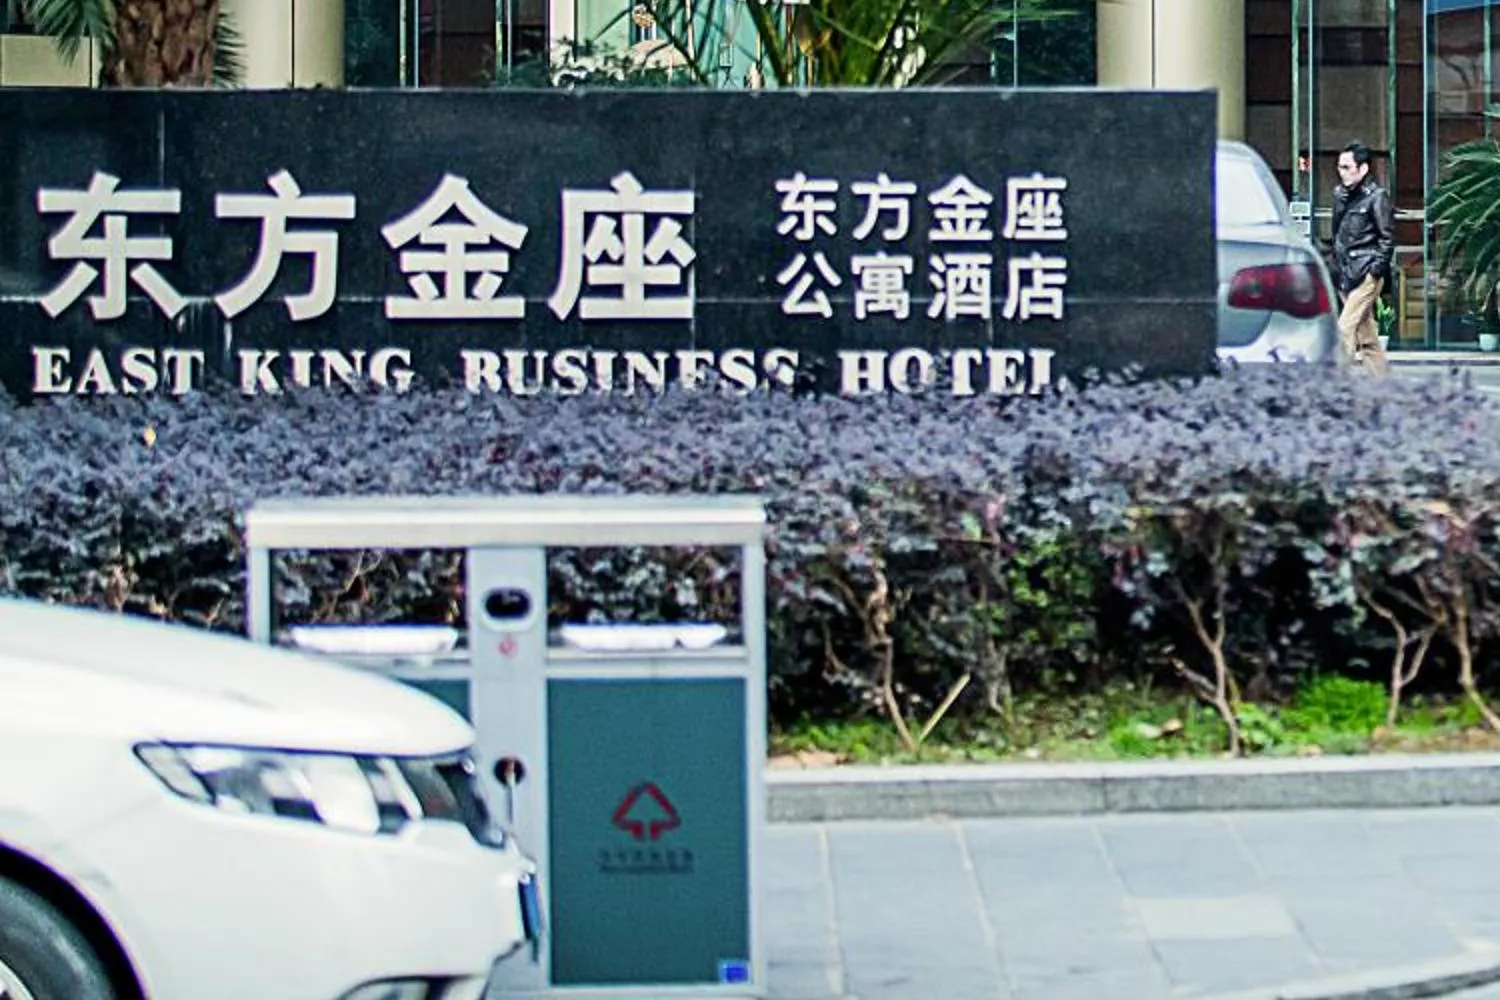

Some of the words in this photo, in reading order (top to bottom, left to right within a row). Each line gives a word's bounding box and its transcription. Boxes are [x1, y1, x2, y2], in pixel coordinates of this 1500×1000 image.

[775, 171, 1068, 241] 东方金座
[37, 170, 697, 321] 东方金座
[776, 250, 1068, 320] 公寓酒店
[31, 346, 205, 395] EAST
[238, 347, 417, 395] KING
